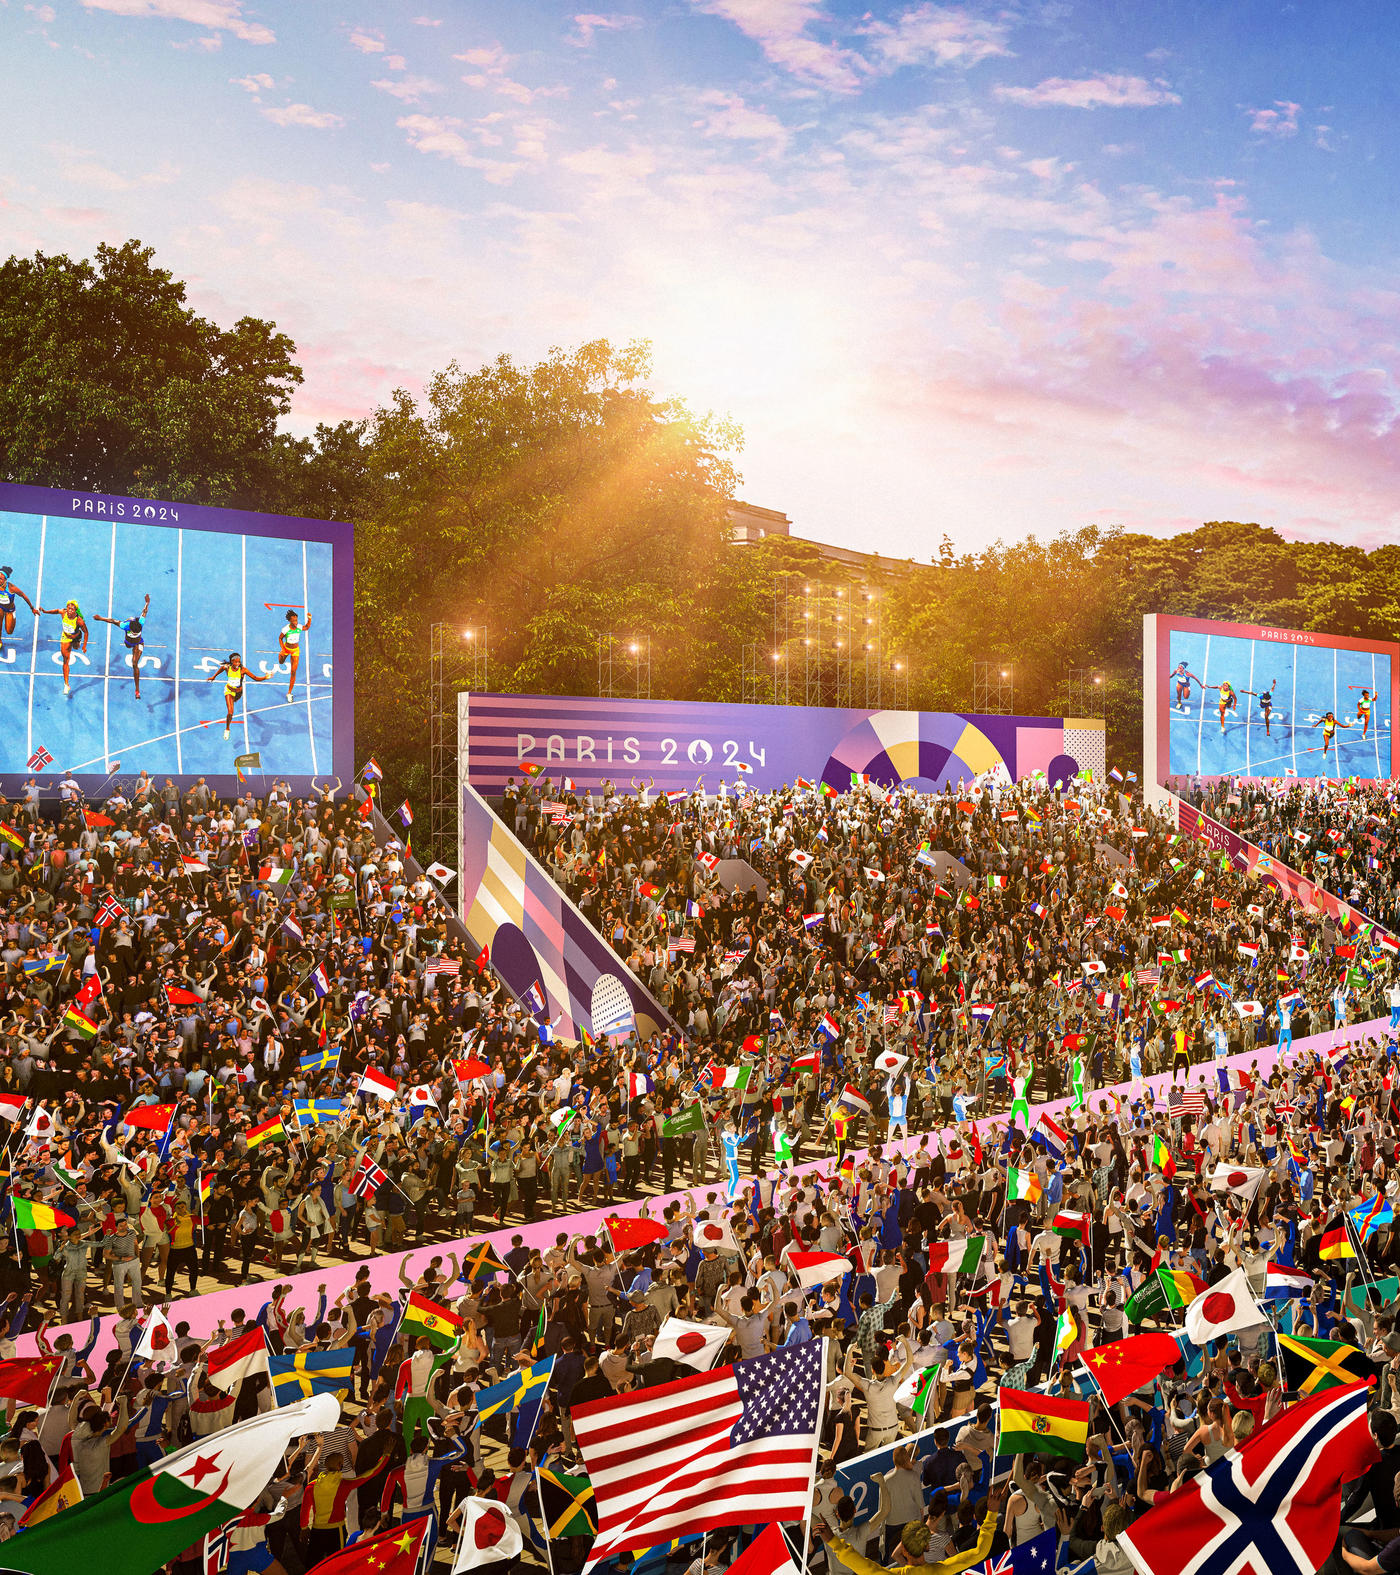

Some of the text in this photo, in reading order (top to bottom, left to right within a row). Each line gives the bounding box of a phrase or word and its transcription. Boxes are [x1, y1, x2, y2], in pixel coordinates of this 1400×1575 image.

[132, 504, 179, 521] 2024
[1290, 633, 1315, 644] 2024
[660, 738, 766, 768] 2024
